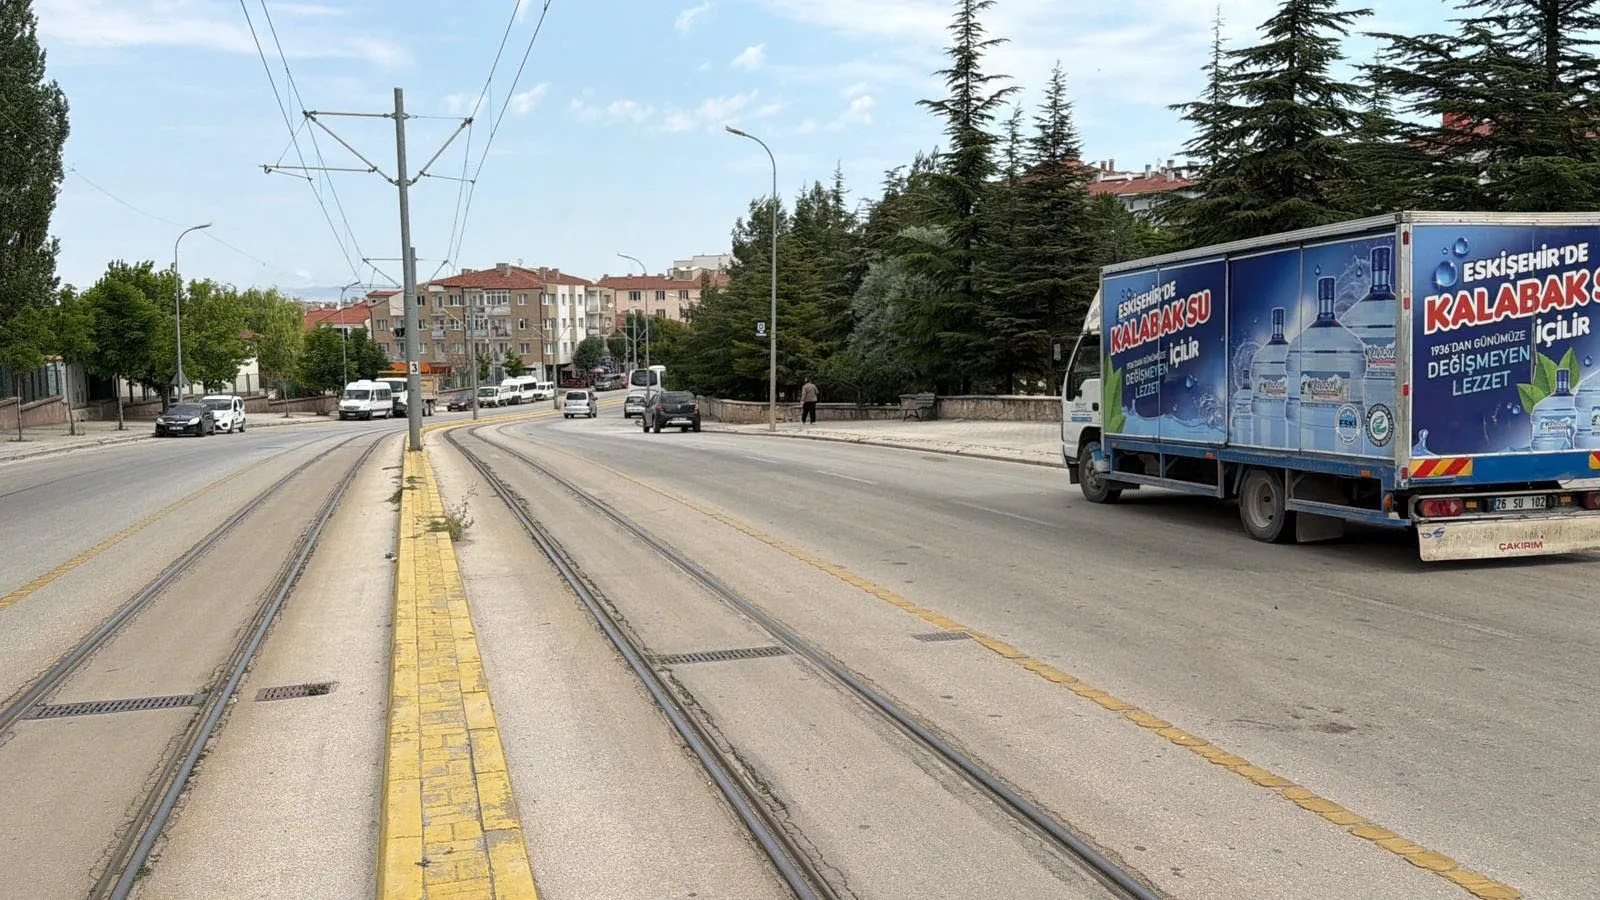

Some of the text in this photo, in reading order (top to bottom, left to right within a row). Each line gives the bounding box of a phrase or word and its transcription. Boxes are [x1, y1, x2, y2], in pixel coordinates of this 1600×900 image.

[1464, 243, 1588, 282] ESKİŞEHİR'DE
[1424, 269, 1590, 335] KALABAK
[1110, 289, 1211, 355] KALABAK SU
[1536, 312, 1591, 347] İÇİLİR
[1169, 336, 1200, 368] İÇİLİR
[1473, 330, 1527, 348] GÜNÜMÜZE
[411, 363, 417, 372] 3
[1427, 345, 1531, 379] DEĞİŞMEYEN
[1135, 381, 1160, 398] LEZZET
[1452, 370, 1511, 396] LEZZET
[1496, 497, 1545, 509] 26 SU 102
[1499, 541, 1543, 552] ÇAKIRIM
